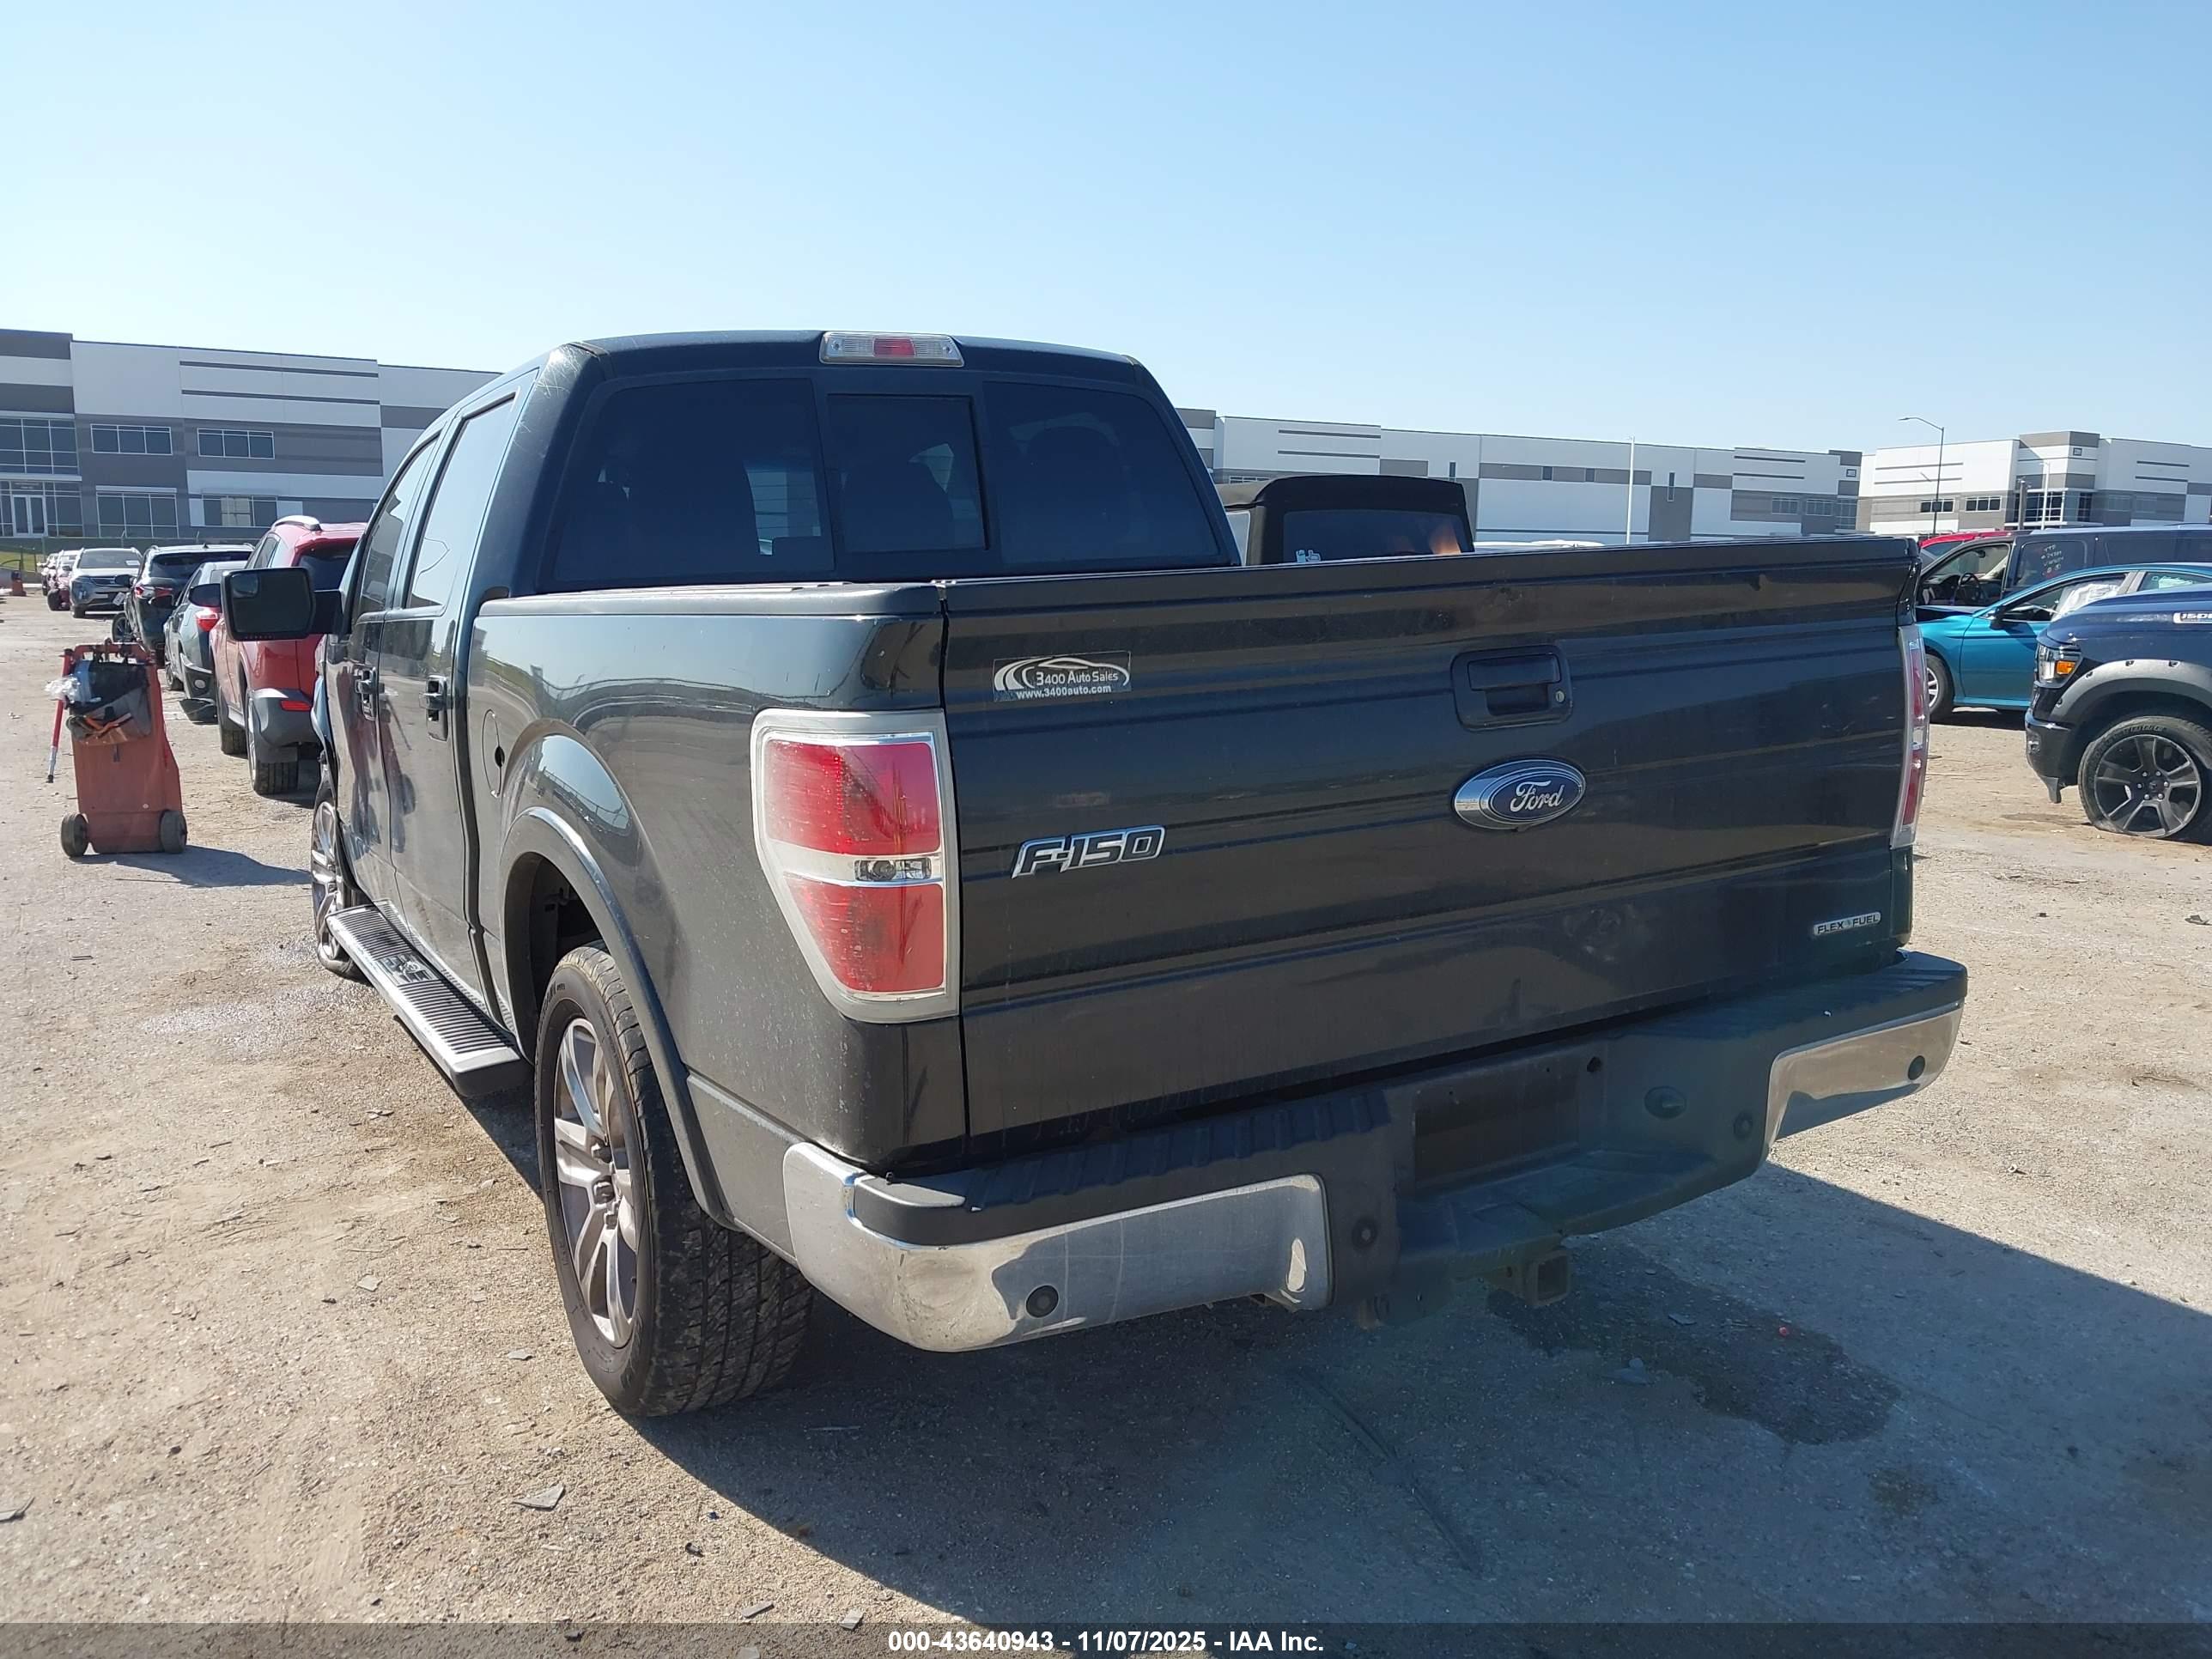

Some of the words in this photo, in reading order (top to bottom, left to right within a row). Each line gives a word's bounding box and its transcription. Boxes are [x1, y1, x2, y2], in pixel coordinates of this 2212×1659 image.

[1036, 671, 1066, 686] 3400
[1067, 671, 1091, 684] Auto
[1091, 671, 1119, 683] Sales
[1016, 684, 1112, 701] www.3400auto.com
[1510, 781, 1565, 812] Ford
[1012, 824, 1165, 878] F-150
[1817, 921, 1844, 934] FLEX
[1852, 915, 1879, 927] FUEL
